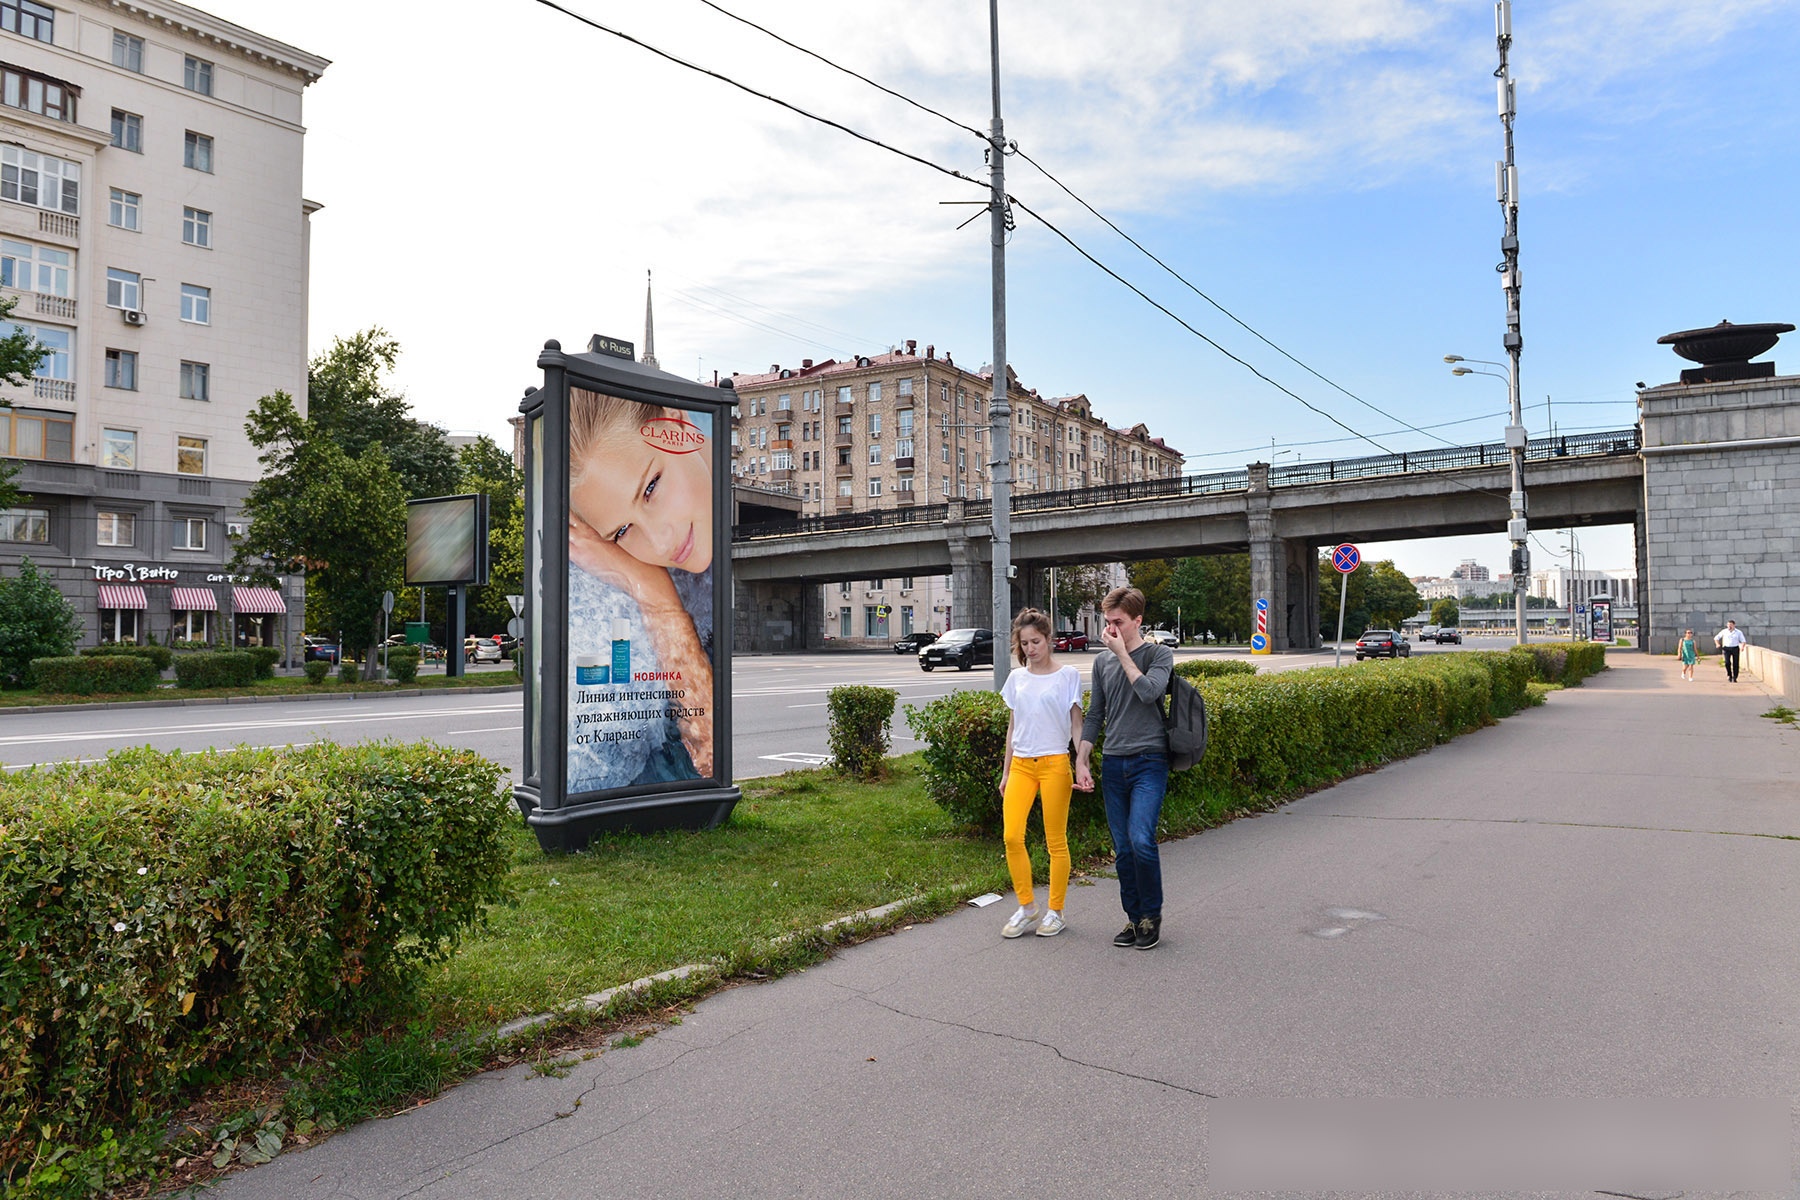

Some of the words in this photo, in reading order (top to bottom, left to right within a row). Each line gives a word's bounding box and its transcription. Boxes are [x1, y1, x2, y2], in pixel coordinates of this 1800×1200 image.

[640, 425, 705, 444] CLARINS
[662, 439, 684, 447] PARIS
[634, 671, 682, 681] НОВИНКА
[576, 690, 616, 704] Линия
[619, 689, 685, 701] интенсивно
[576, 709, 662, 728] увлажняющих
[664, 706, 705, 720] средств
[576, 734, 590, 745] от
[593, 729, 642, 745] Кларанс
